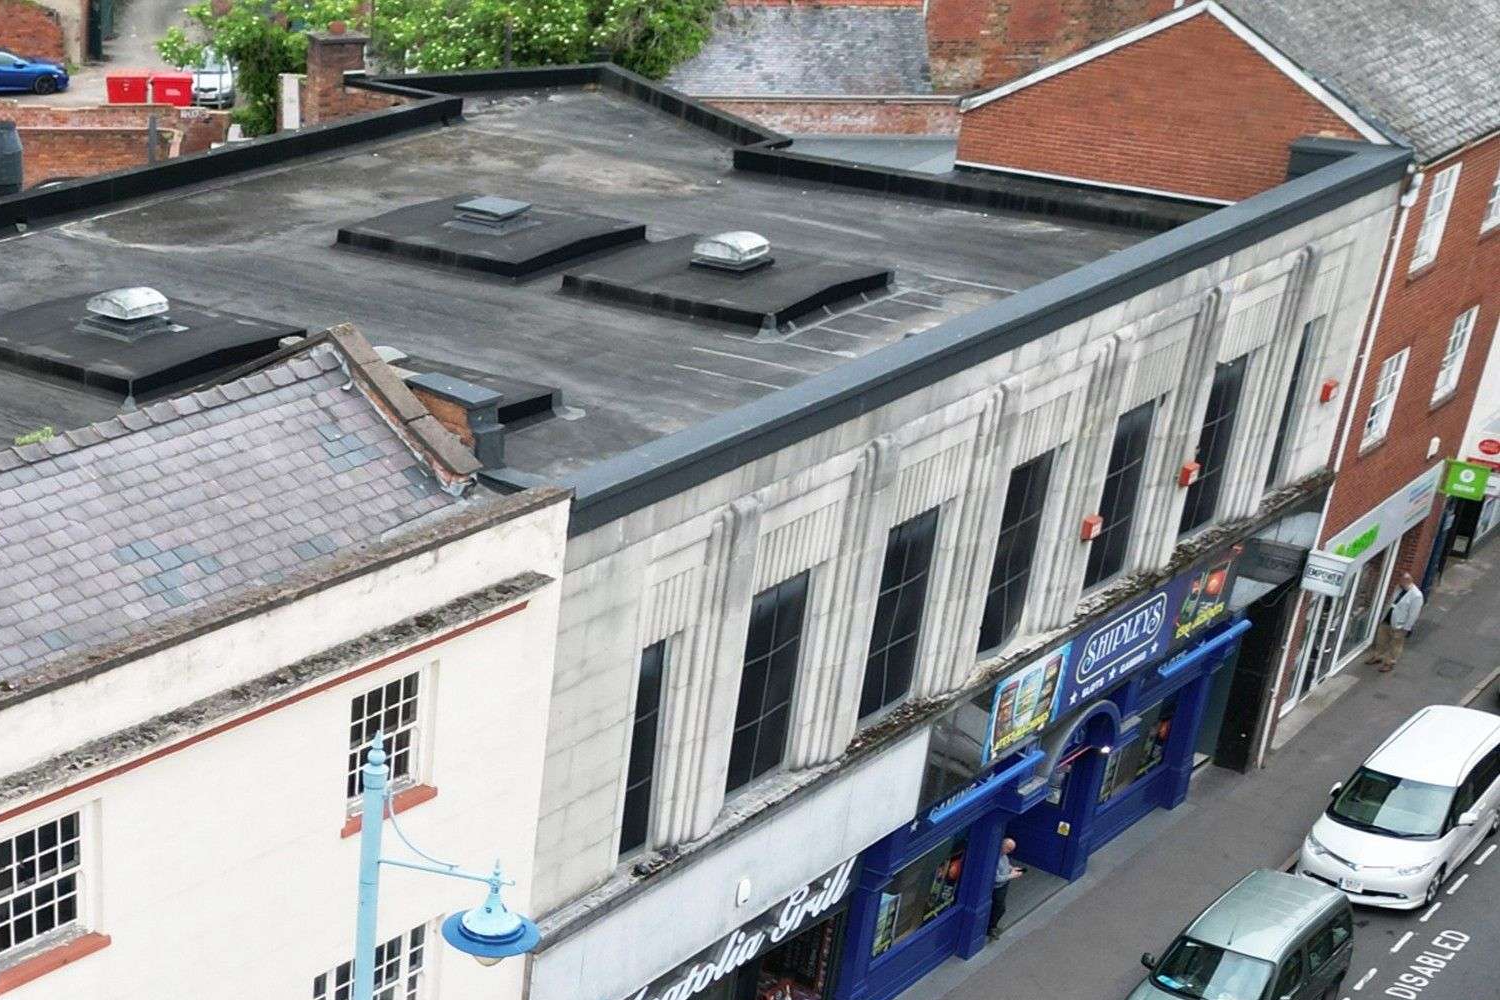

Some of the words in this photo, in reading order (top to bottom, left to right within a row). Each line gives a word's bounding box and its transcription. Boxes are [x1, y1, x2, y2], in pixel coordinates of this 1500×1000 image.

[1081, 602, 1162, 674] SHIPLEYS
[771, 855, 857, 943] Grill
[1385, 930, 1470, 1000] DISABLED
